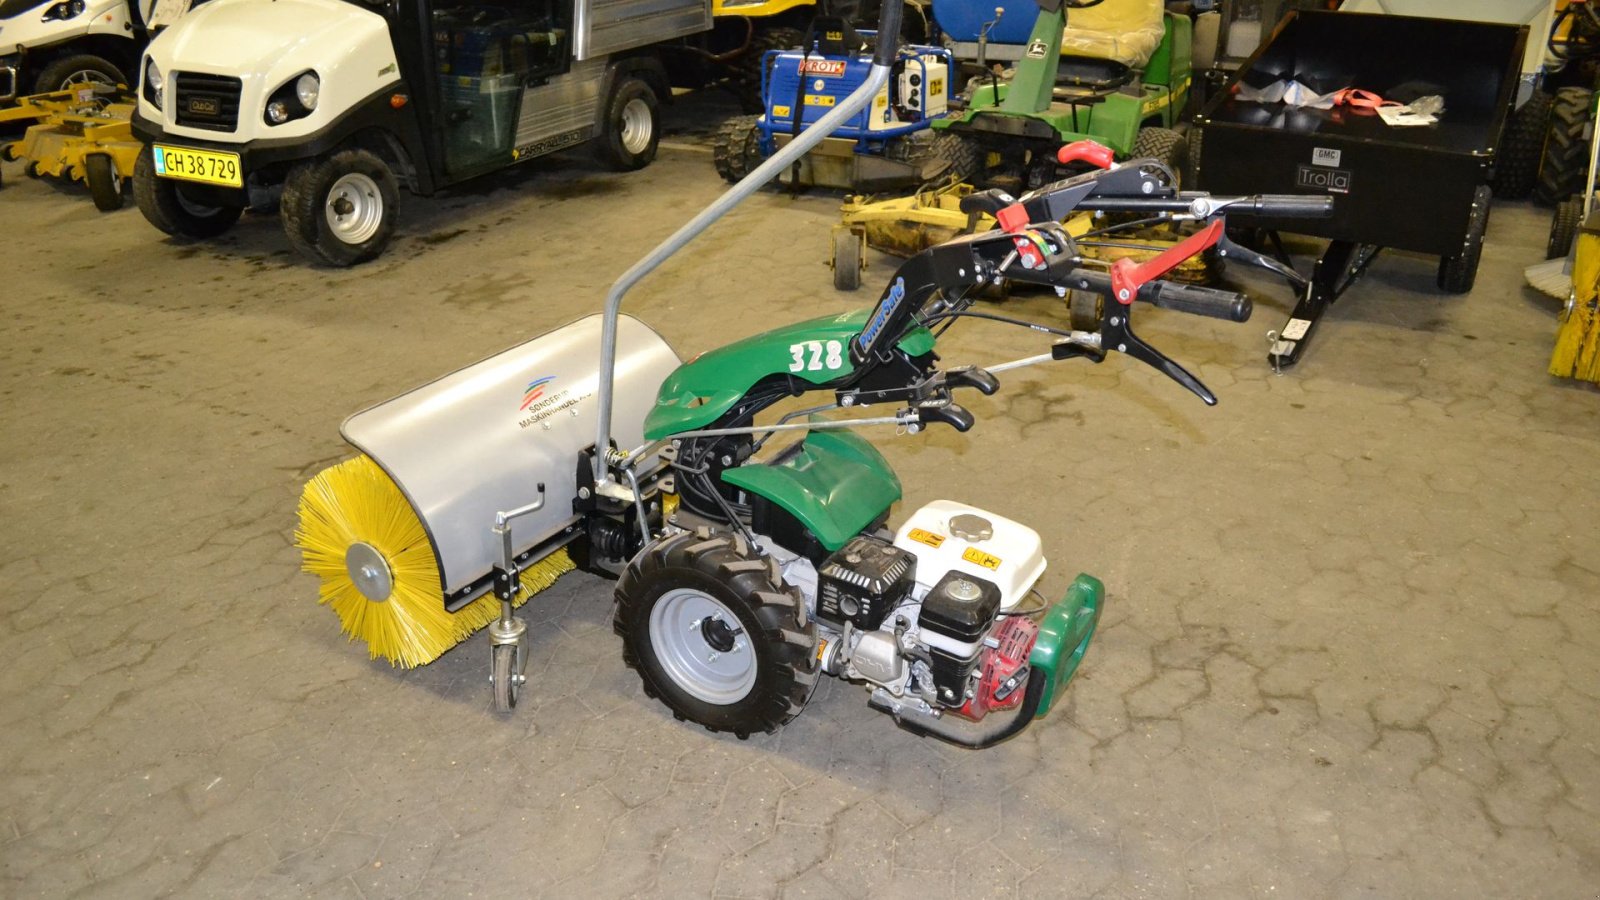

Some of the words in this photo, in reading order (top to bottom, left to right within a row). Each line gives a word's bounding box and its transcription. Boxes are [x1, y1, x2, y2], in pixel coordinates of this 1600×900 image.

[520, 135, 560, 157] CARRYALL
[1318, 150, 1336, 159] GMC
[165, 152, 184, 172] CH
[188, 155, 205, 175] 38
[209, 158, 236, 179] 729
[1302, 169, 1347, 187] Trolla
[789, 340, 842, 372] 328
